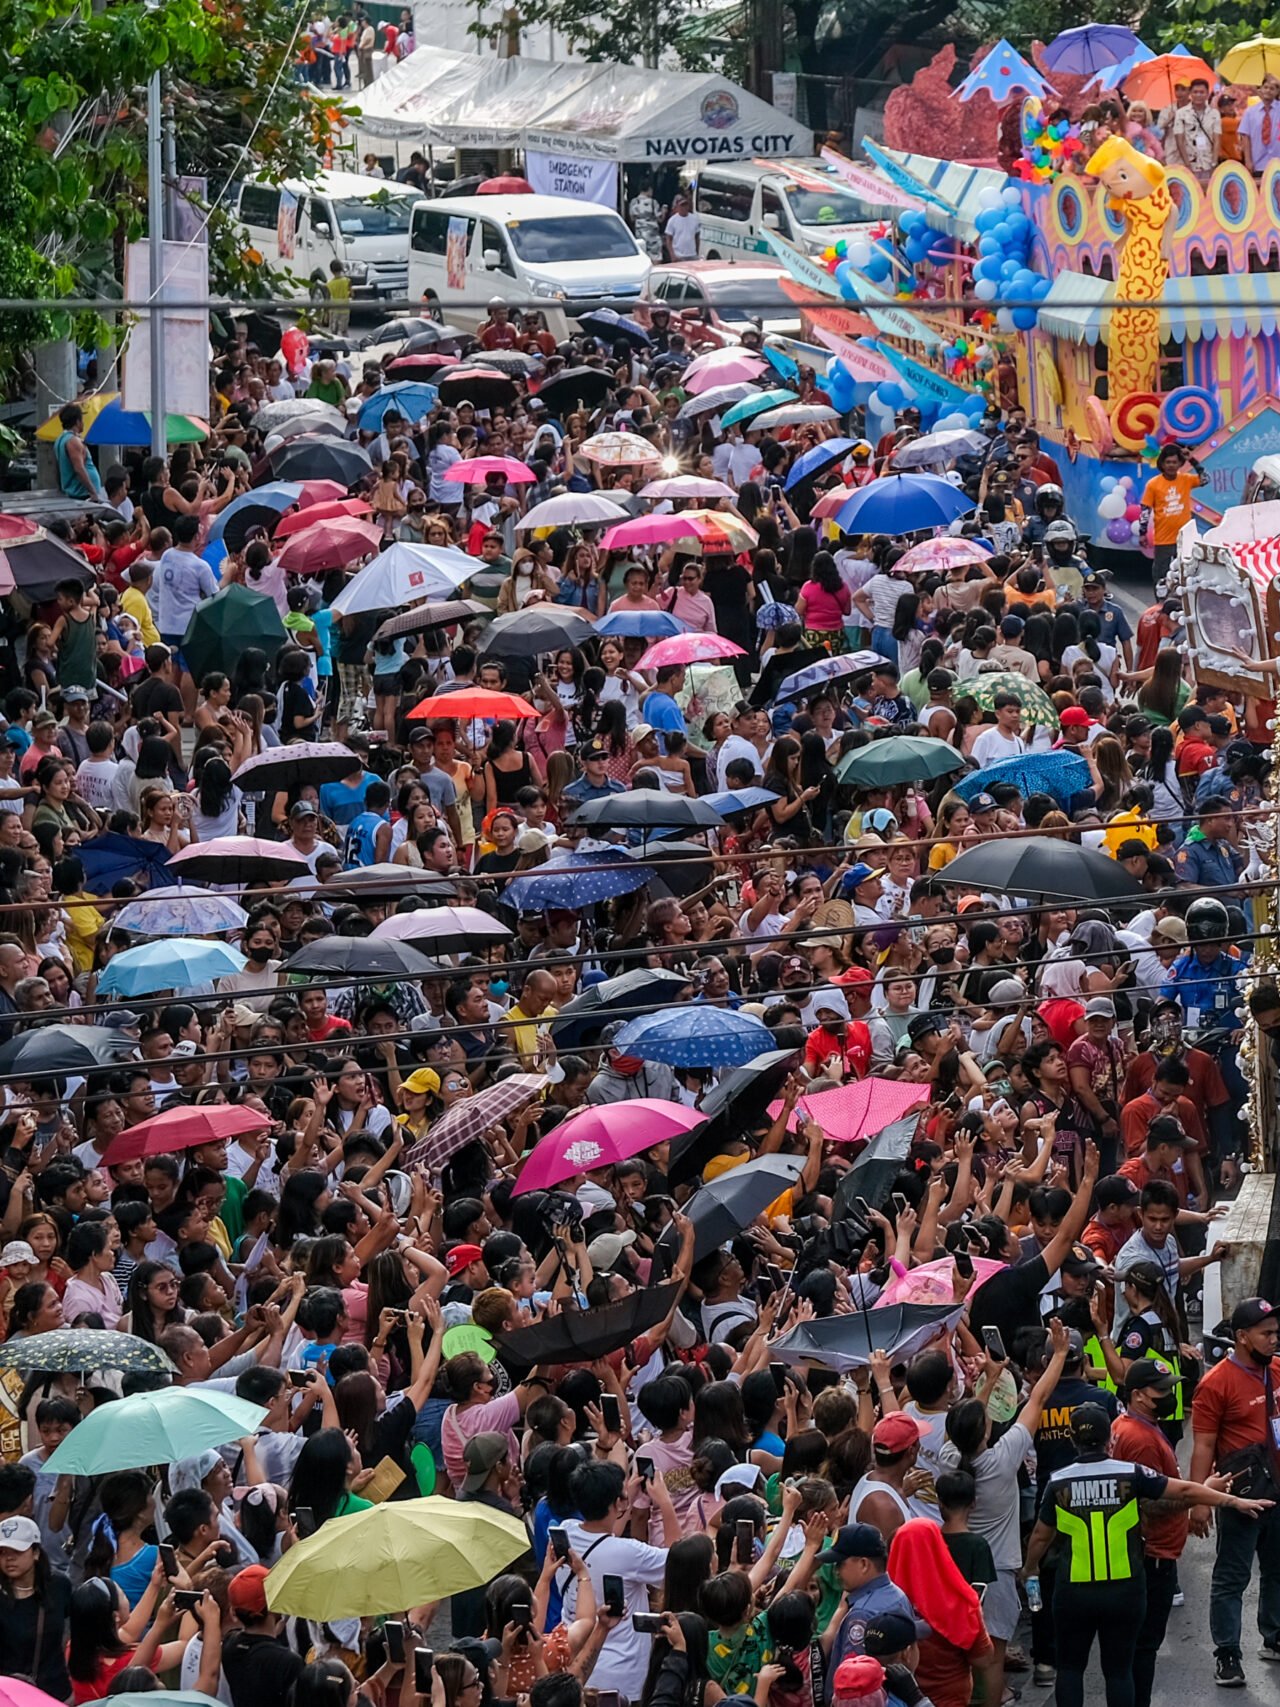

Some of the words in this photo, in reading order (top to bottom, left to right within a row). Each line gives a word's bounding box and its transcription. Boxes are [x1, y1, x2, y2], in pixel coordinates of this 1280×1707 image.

[646, 136, 745, 156] NAVOTAS
[752, 134, 795, 152] CITY
[549, 160, 593, 180] EMERGENCY
[554, 178, 585, 194] STATION
[1213, 466, 1248, 493] BEC
[1038, 1406, 1077, 1428] MM
[1040, 1428, 1071, 1441] ANTI-C
[1071, 1480, 1118, 1500] MMTF
[1070, 1497, 1121, 1508] ANTI-CRIME
